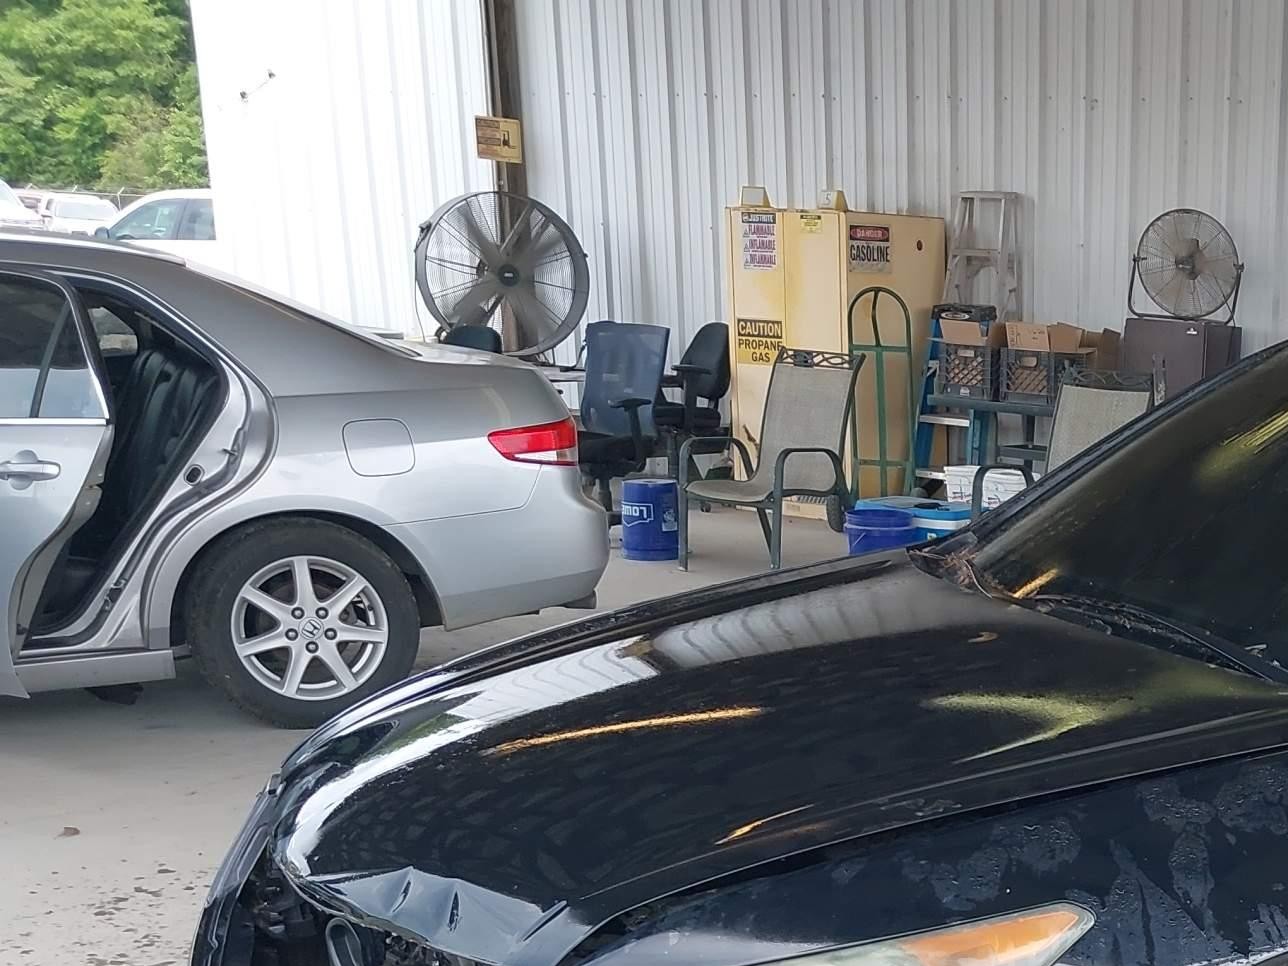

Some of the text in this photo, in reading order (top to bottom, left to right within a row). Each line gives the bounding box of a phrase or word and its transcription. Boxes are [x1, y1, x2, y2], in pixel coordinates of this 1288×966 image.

[856, 229, 883, 238] DANGER
[850, 245, 890, 262] GASOLINE
[739, 322, 782, 336] CAUTION
[751, 351, 770, 363] GAS
